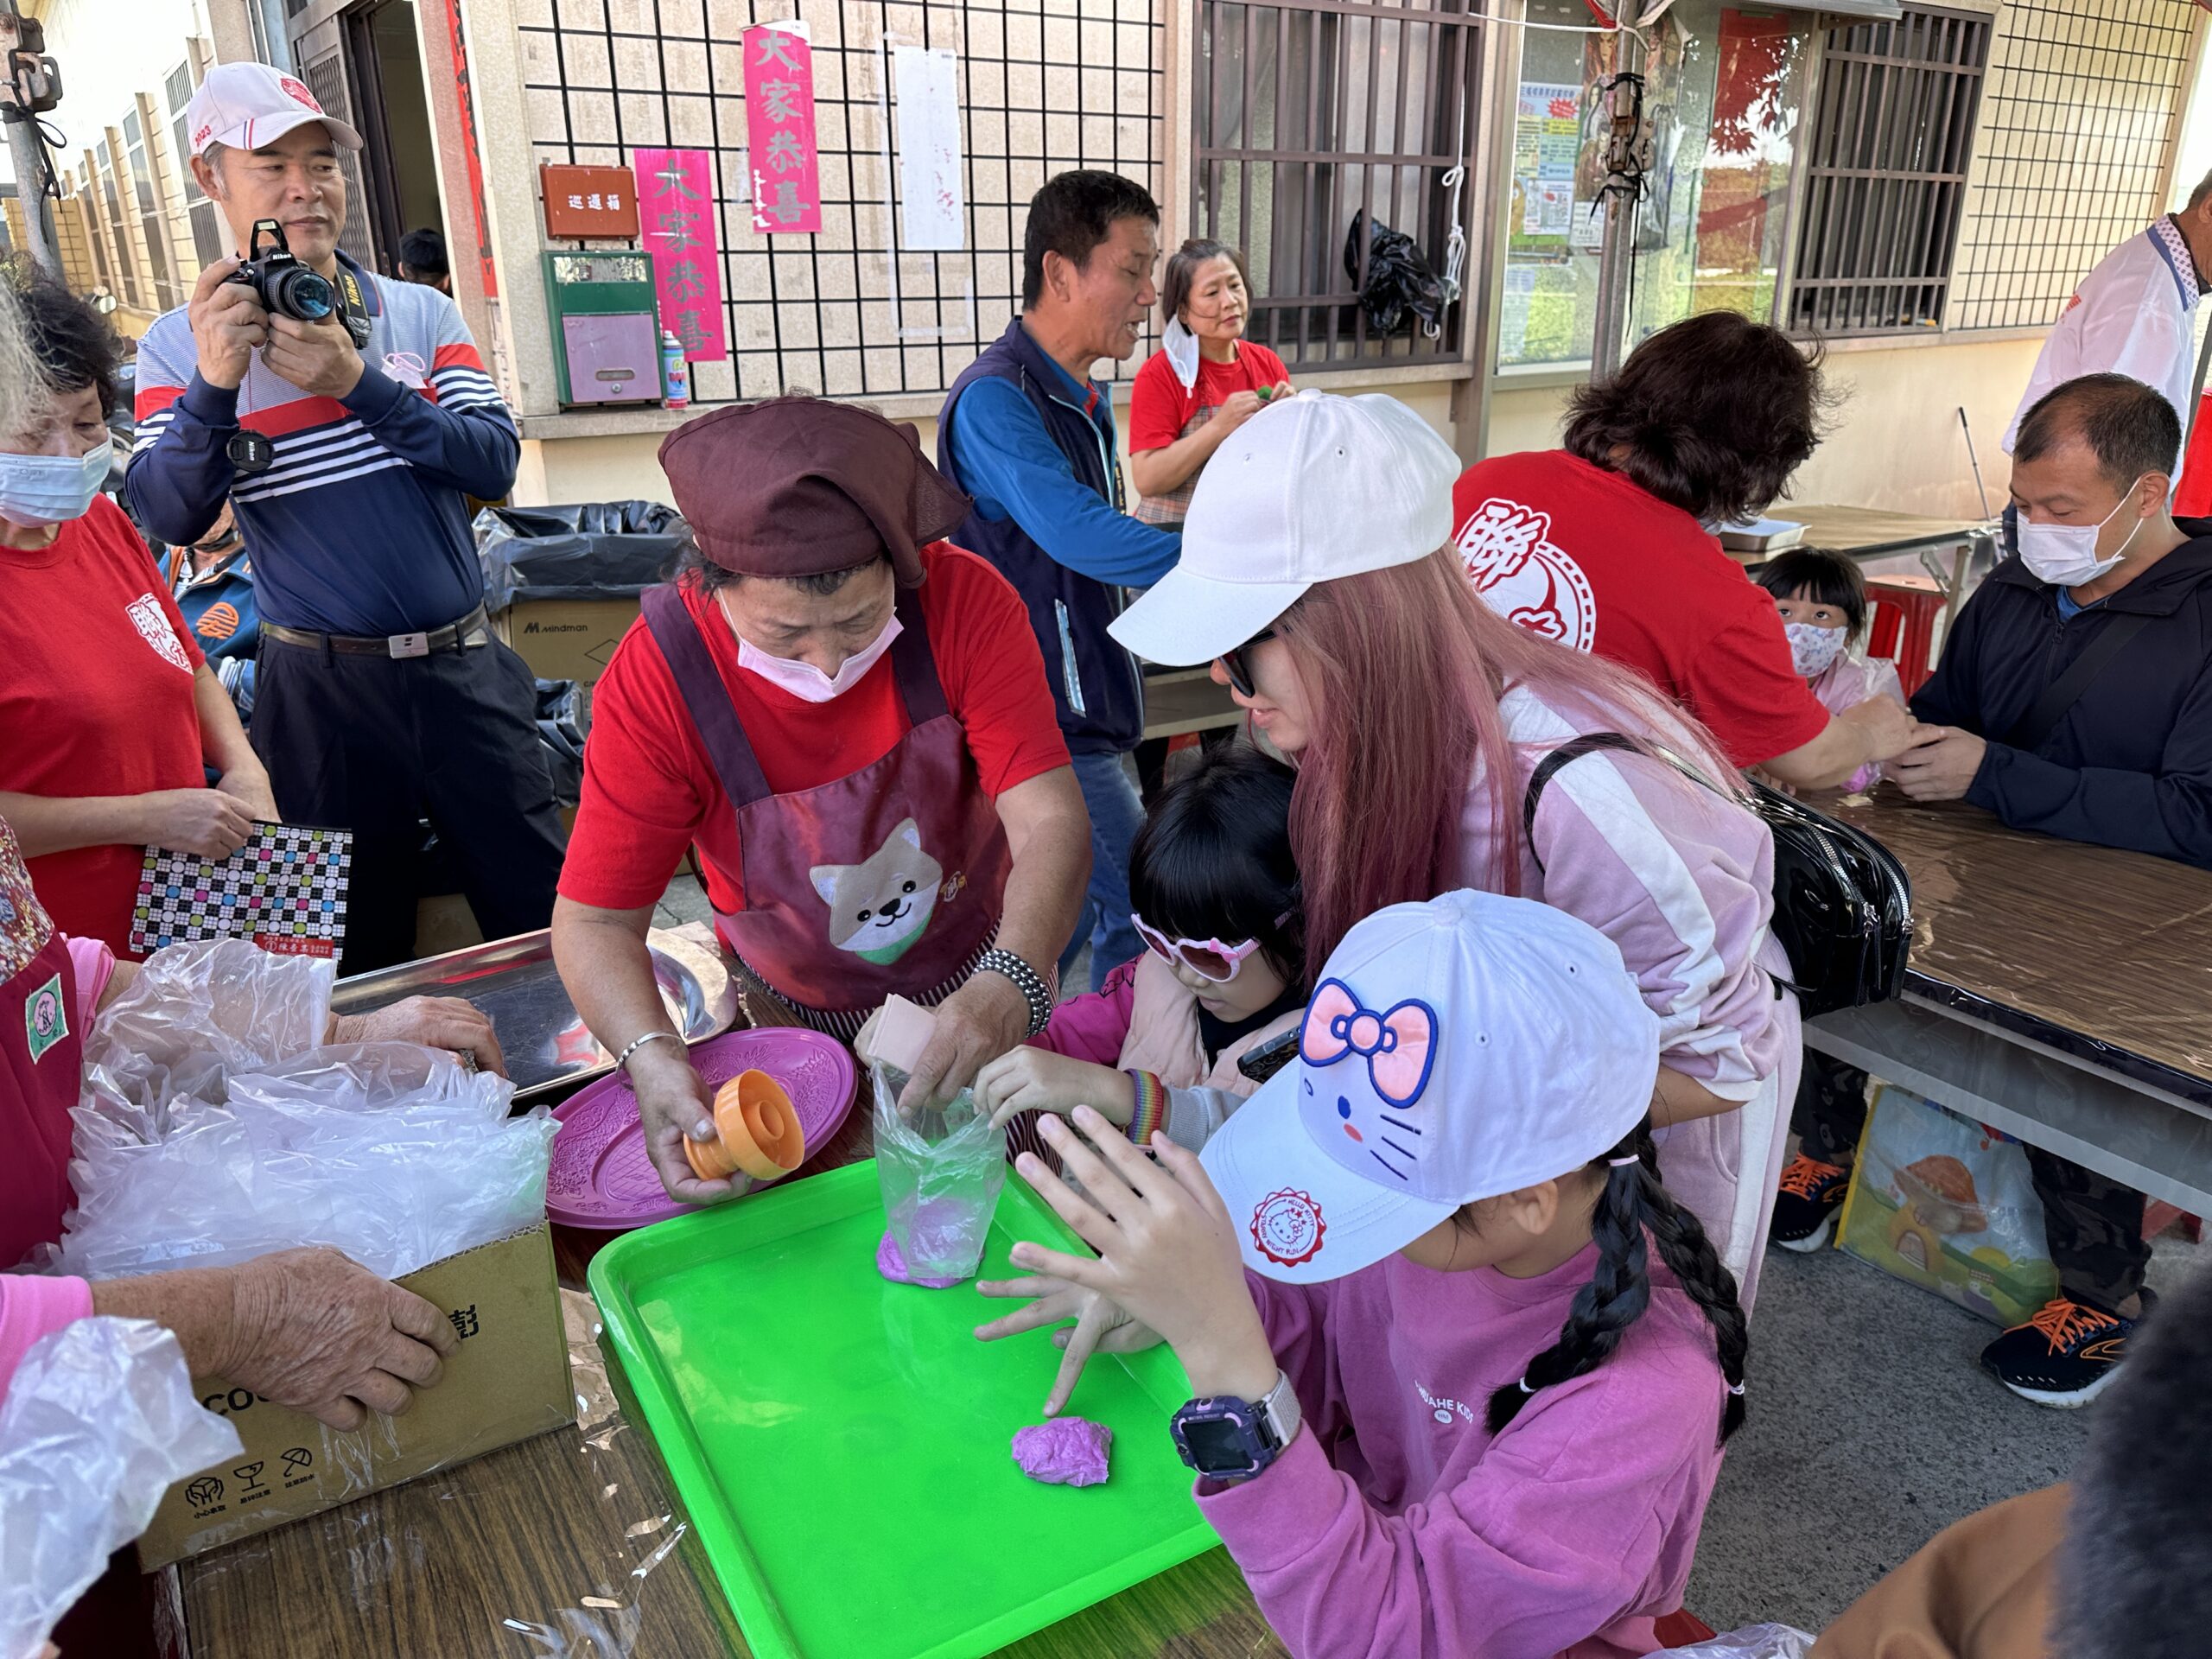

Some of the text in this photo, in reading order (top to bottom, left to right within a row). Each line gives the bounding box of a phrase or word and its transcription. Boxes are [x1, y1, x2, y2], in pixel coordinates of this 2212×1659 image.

[194, 124, 212, 148] 2023
[754, 30, 810, 225] 大家恭喜
[568, 193, 620, 211] 巡邏箱
[652, 158, 713, 352] 大家恭喜
[344, 274, 361, 307] Nikon
[1288, 1199, 1314, 1226] HELLO KITTY
[1266, 1239, 1285, 1255] NIGHT
[1457, 1401, 1474, 1425] KIDS
